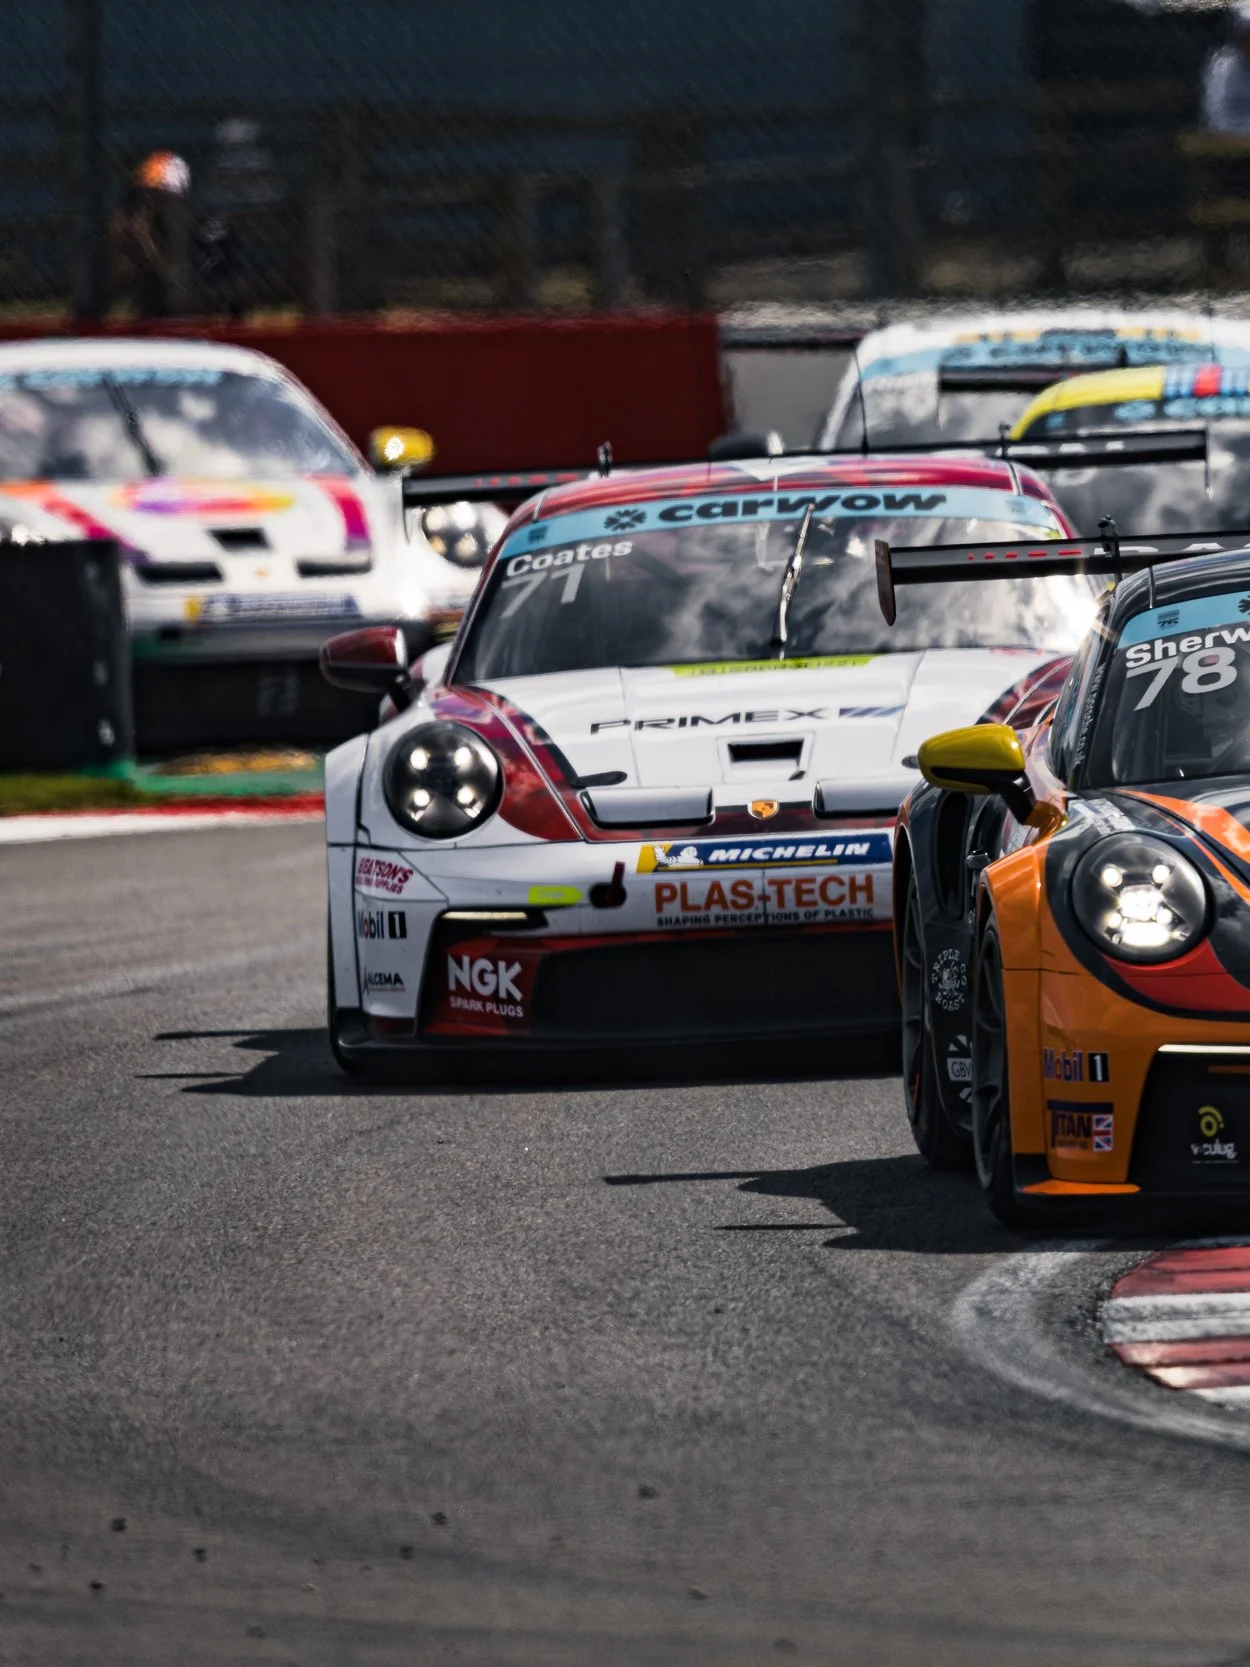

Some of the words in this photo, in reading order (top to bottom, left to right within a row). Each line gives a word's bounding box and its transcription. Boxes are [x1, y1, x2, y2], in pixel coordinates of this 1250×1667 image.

[658, 493, 947, 523] carwow
[505, 538, 633, 578] Coates
[500, 563, 584, 619] 71
[1125, 646, 1238, 712] 78
[590, 707, 827, 734] PRIMEX
[708, 843, 870, 862] MICHELIN
[358, 911, 385, 940] Mobil
[657, 914, 711, 928] SHAPING
[714, 911, 800, 925] PERCEPTIONS
[803, 909, 819, 920] OF
[824, 907, 874, 919] PLASTIC
[448, 955, 523, 1002] NGK
[450, 996, 485, 1013] SPARK
[486, 998, 523, 1017] PLUGS
[1043, 1048, 1084, 1082] Mobil
